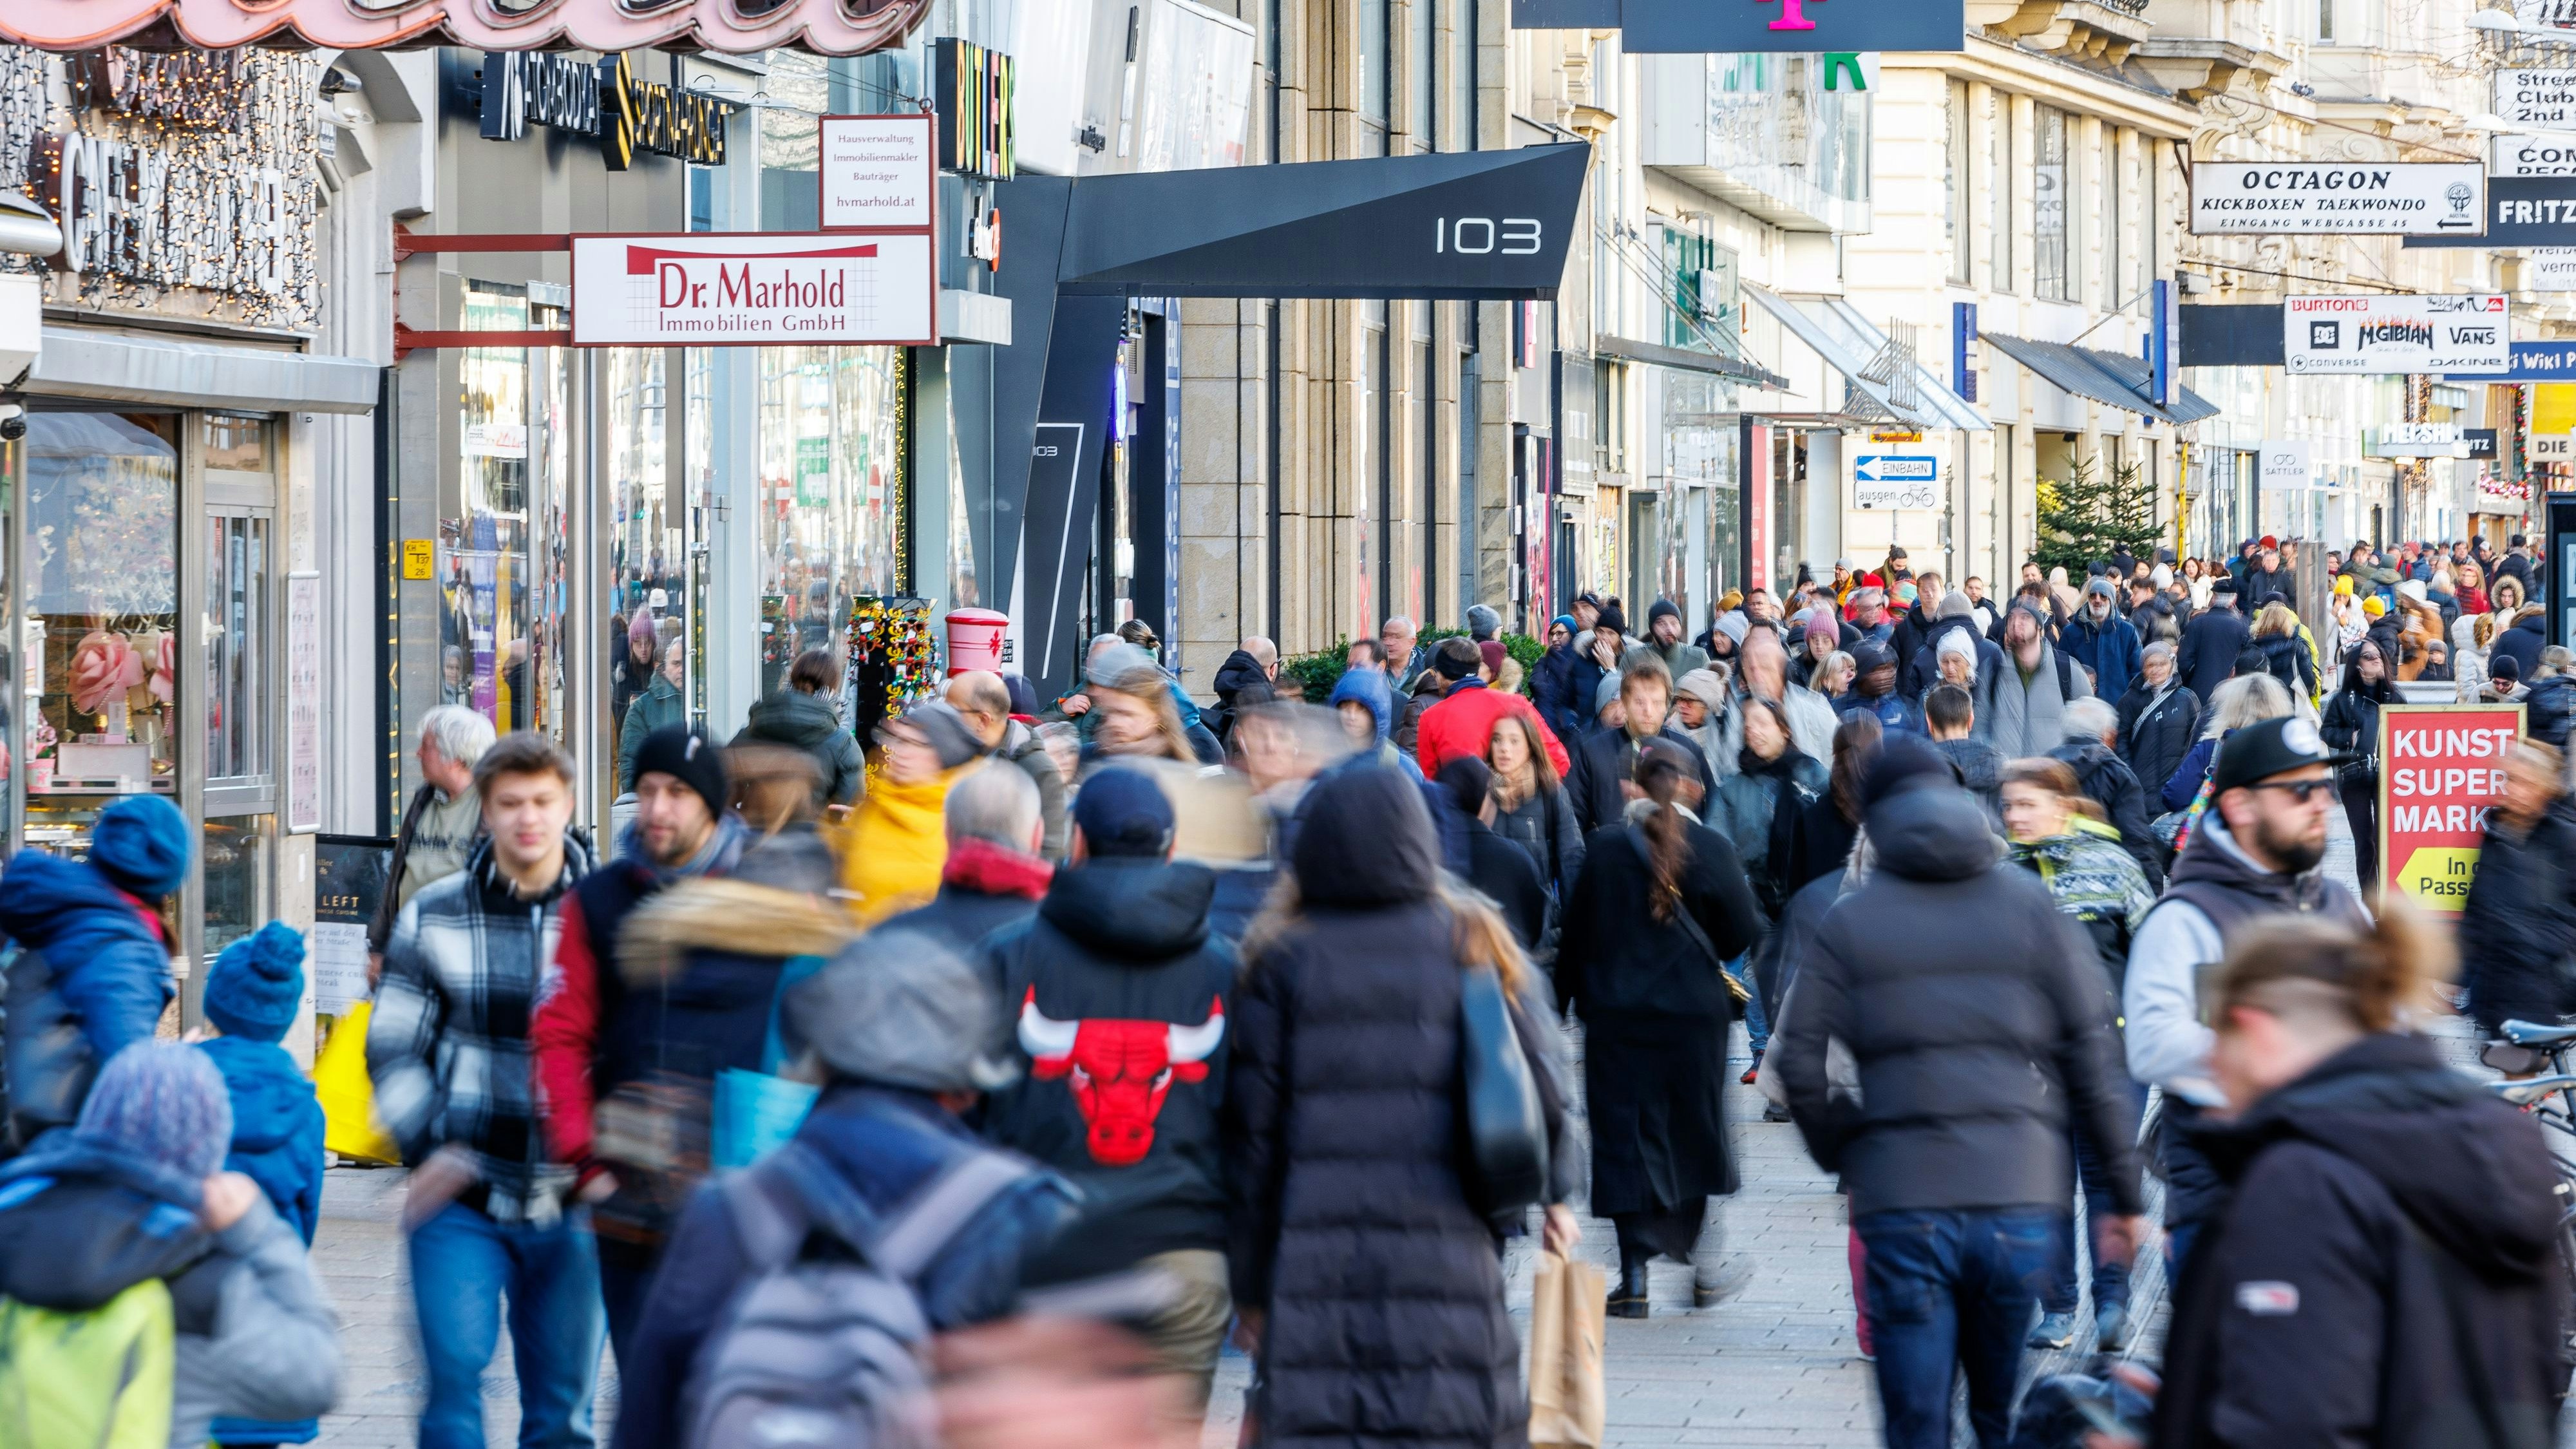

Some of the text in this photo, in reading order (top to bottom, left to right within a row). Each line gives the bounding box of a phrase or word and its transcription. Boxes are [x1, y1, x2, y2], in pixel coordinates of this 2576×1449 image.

[2517, 91, 2575, 103] Club
[956, 40, 1016, 182] BUTLERS
[2517, 109, 2564, 121] 2nd
[838, 134, 914, 145] Hausverwaltung
[834, 153, 919, 162] Immobilienmakler
[853, 173, 899, 183] Bauträger
[2242, 171, 2392, 189] OCTAGON
[837, 196, 915, 207] hvmarhold.at
[2201, 198, 2426, 211] KICKBOXEN TAEKWONDO
[2220, 218, 2291, 227] EINGANG
[2302, 218, 2385, 227] WEBGASSE
[1437, 218, 1542, 254] 103
[659, 262, 844, 308] Dr. Marhold
[2291, 299, 2354, 311] BURTON
[659, 311, 845, 331] Immobilien GmbH
[2449, 327, 2496, 345] VANS
[2429, 358, 2503, 366] DAKINE
[2538, 440, 2568, 453] DIE
[1882, 462, 1928, 474] EINBAHN
[1859, 491, 1900, 503] ausgen.
[2394, 728, 2514, 757] KUNST
[2392, 768, 2509, 797] SUPER
[2394, 805, 2494, 833] MARK
[2448, 857, 2466, 875] In
[323, 895, 359, 907] LEFT
